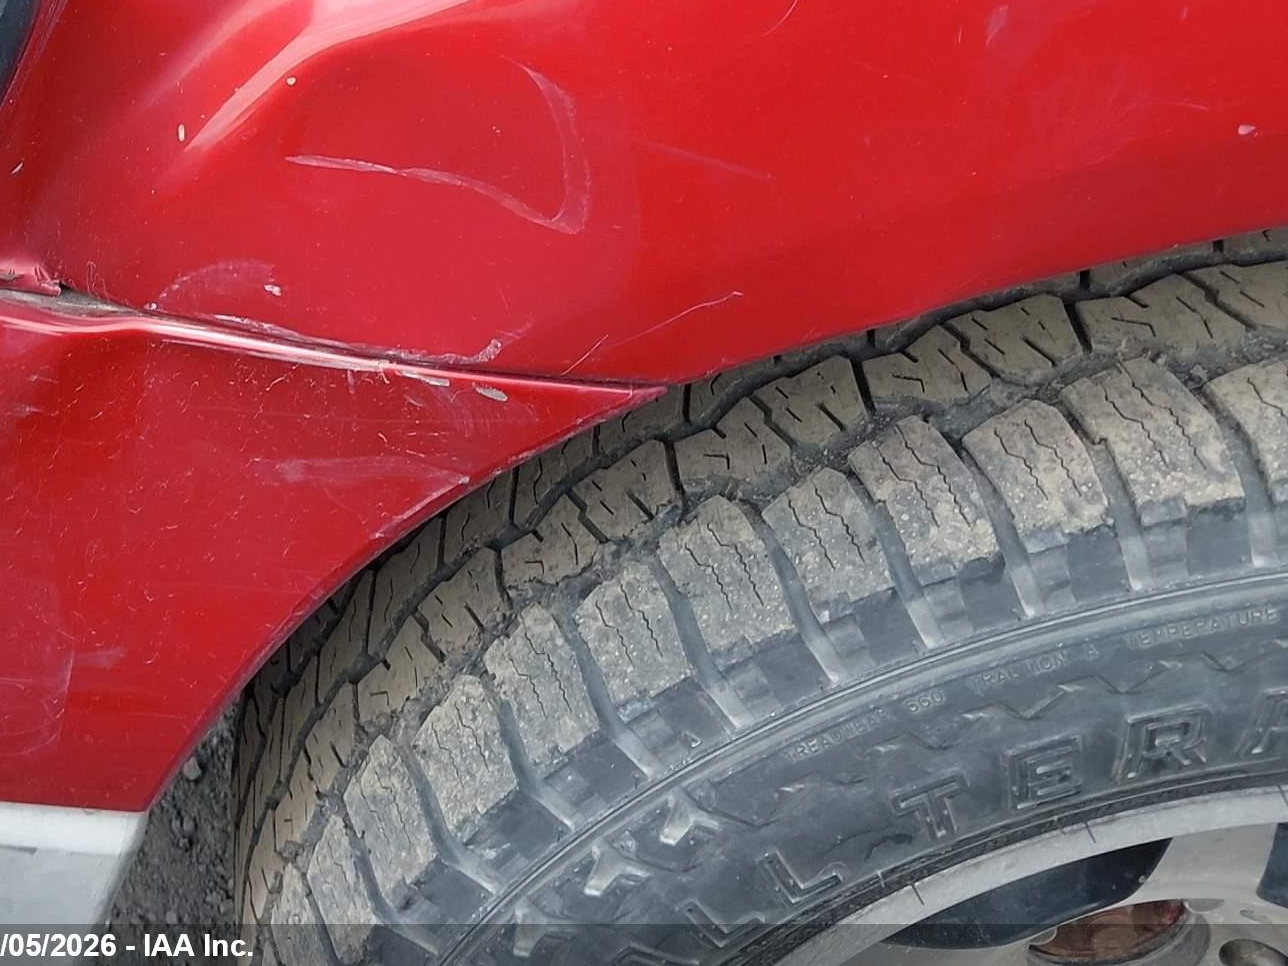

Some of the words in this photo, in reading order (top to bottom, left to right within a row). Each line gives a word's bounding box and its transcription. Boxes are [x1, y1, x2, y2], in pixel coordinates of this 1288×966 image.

[785, 708, 890, 762] TREADWEAR
[973, 648, 1065, 696] TRACTION
[1128, 607, 1280, 649] TEMPERATURE
